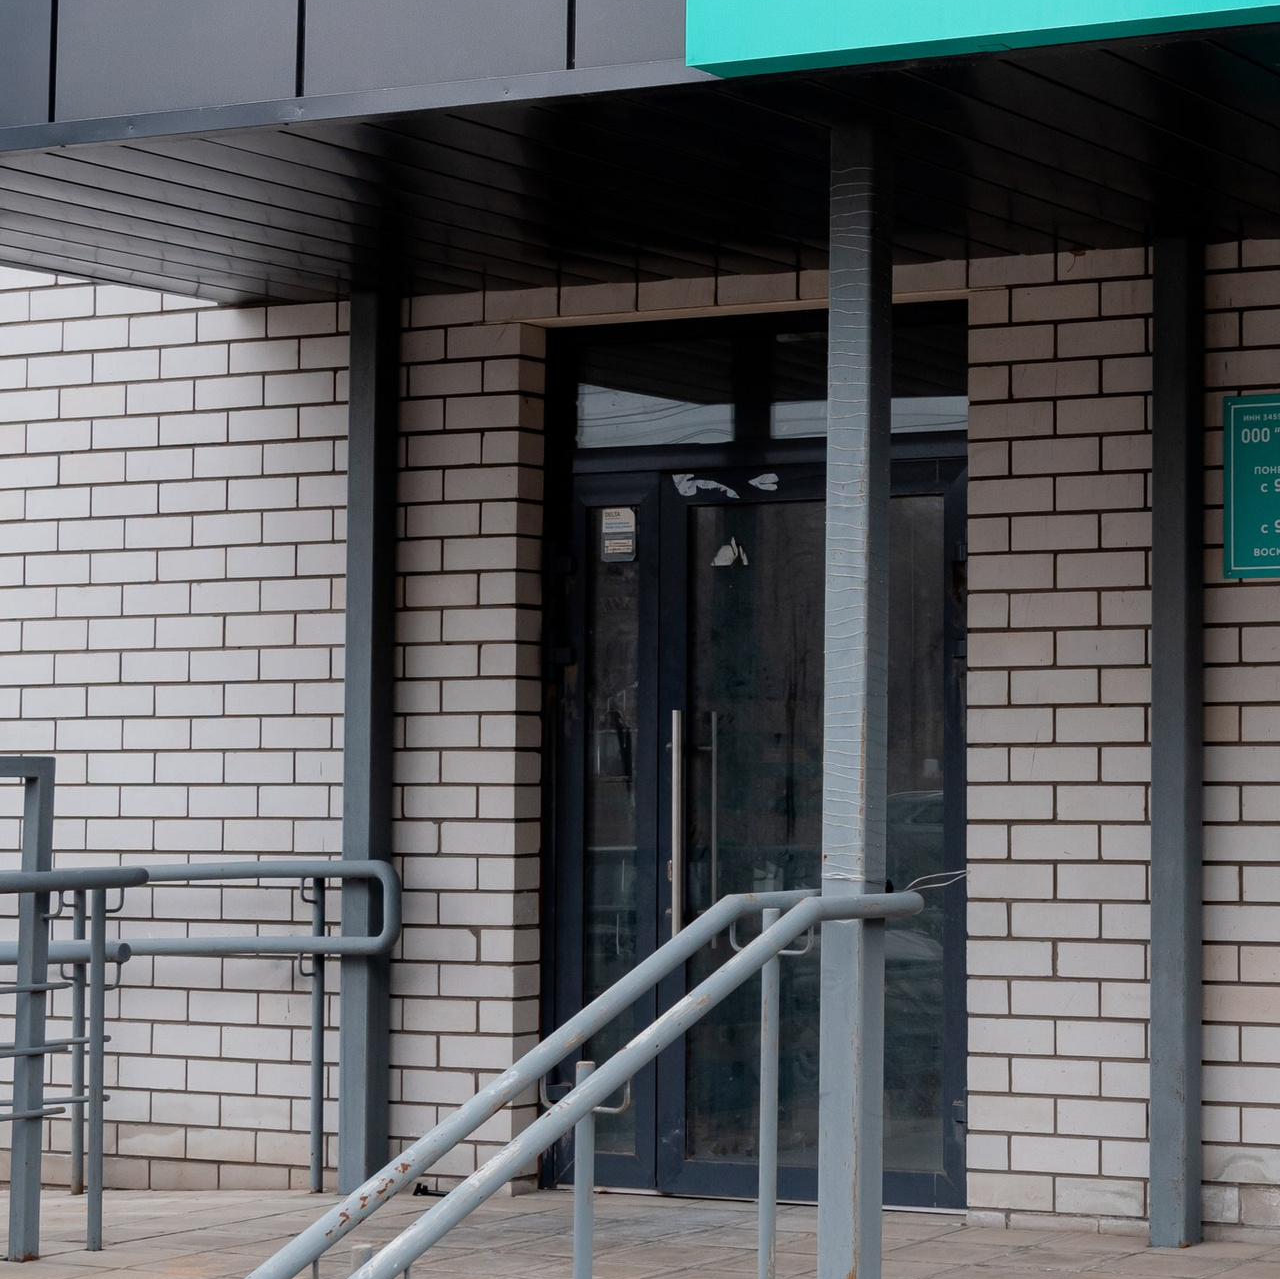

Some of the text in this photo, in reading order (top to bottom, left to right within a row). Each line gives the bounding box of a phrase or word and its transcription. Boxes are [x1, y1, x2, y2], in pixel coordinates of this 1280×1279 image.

[1241, 427, 1271, 443] ООО
[1260, 483, 1269, 493] с
[1260, 524, 1269, 534] с
